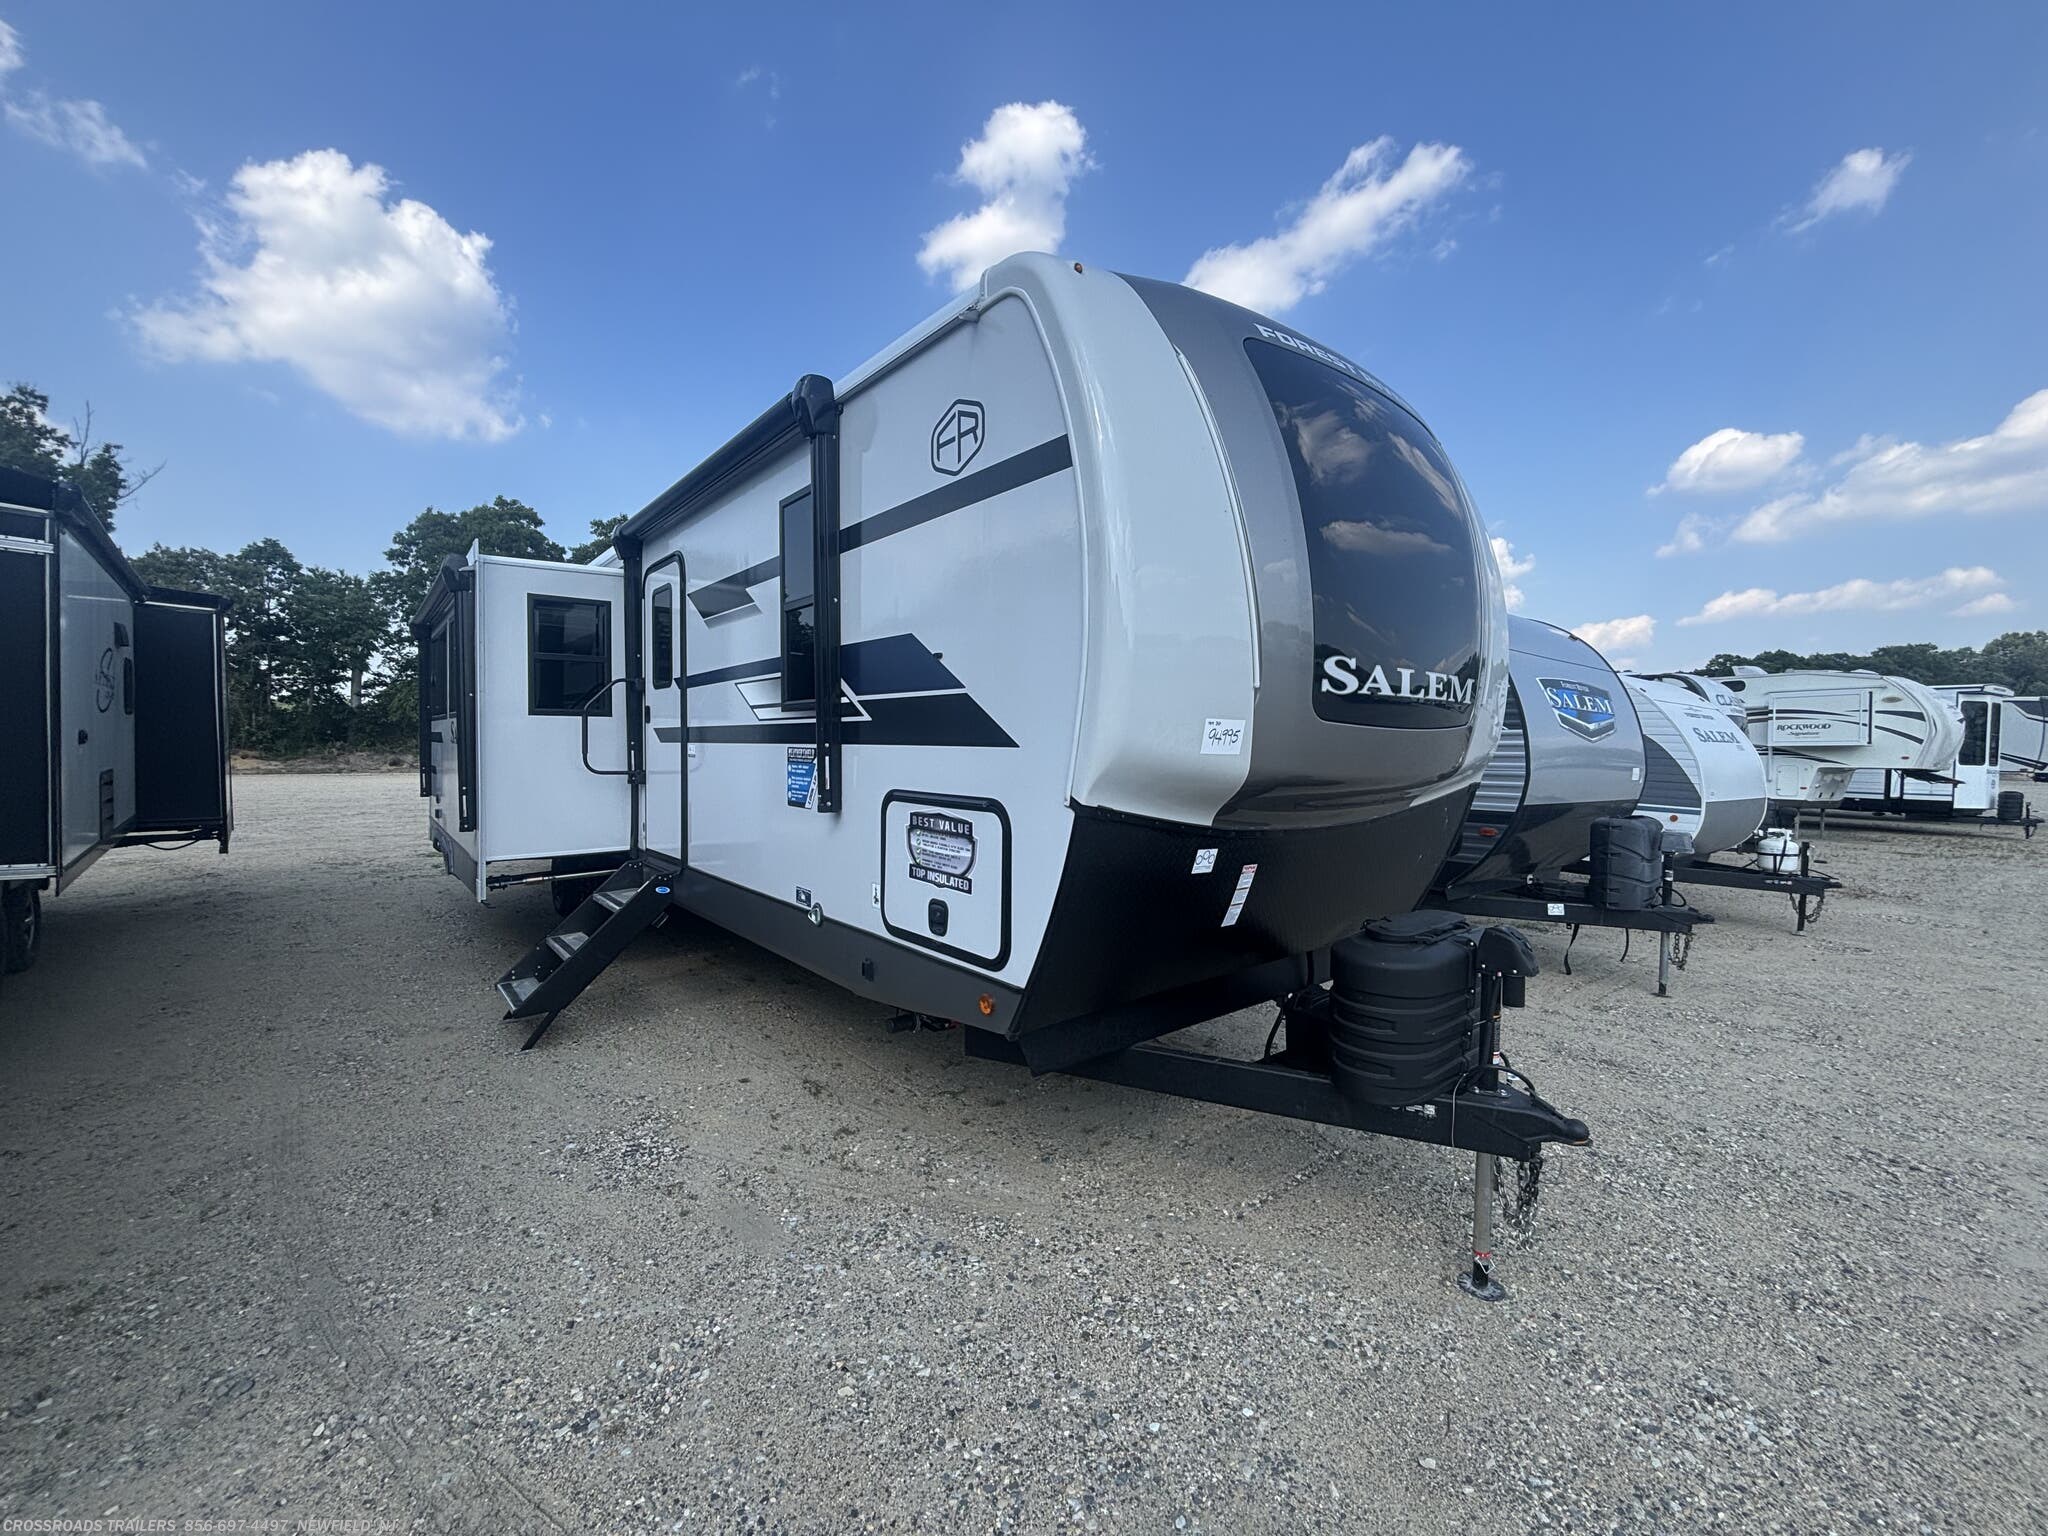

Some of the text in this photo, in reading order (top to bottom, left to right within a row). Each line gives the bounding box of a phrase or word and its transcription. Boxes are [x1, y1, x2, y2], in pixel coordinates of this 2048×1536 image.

[1252, 322, 1357, 375] FOREST
[1321, 655, 1475, 704] SALEM
[1546, 687, 1615, 715] SALEM
[1693, 727, 1740, 743] SALEM
[912, 816, 970, 835] BEST VALUE
[911, 866, 969, 890] TOP INSULATED
